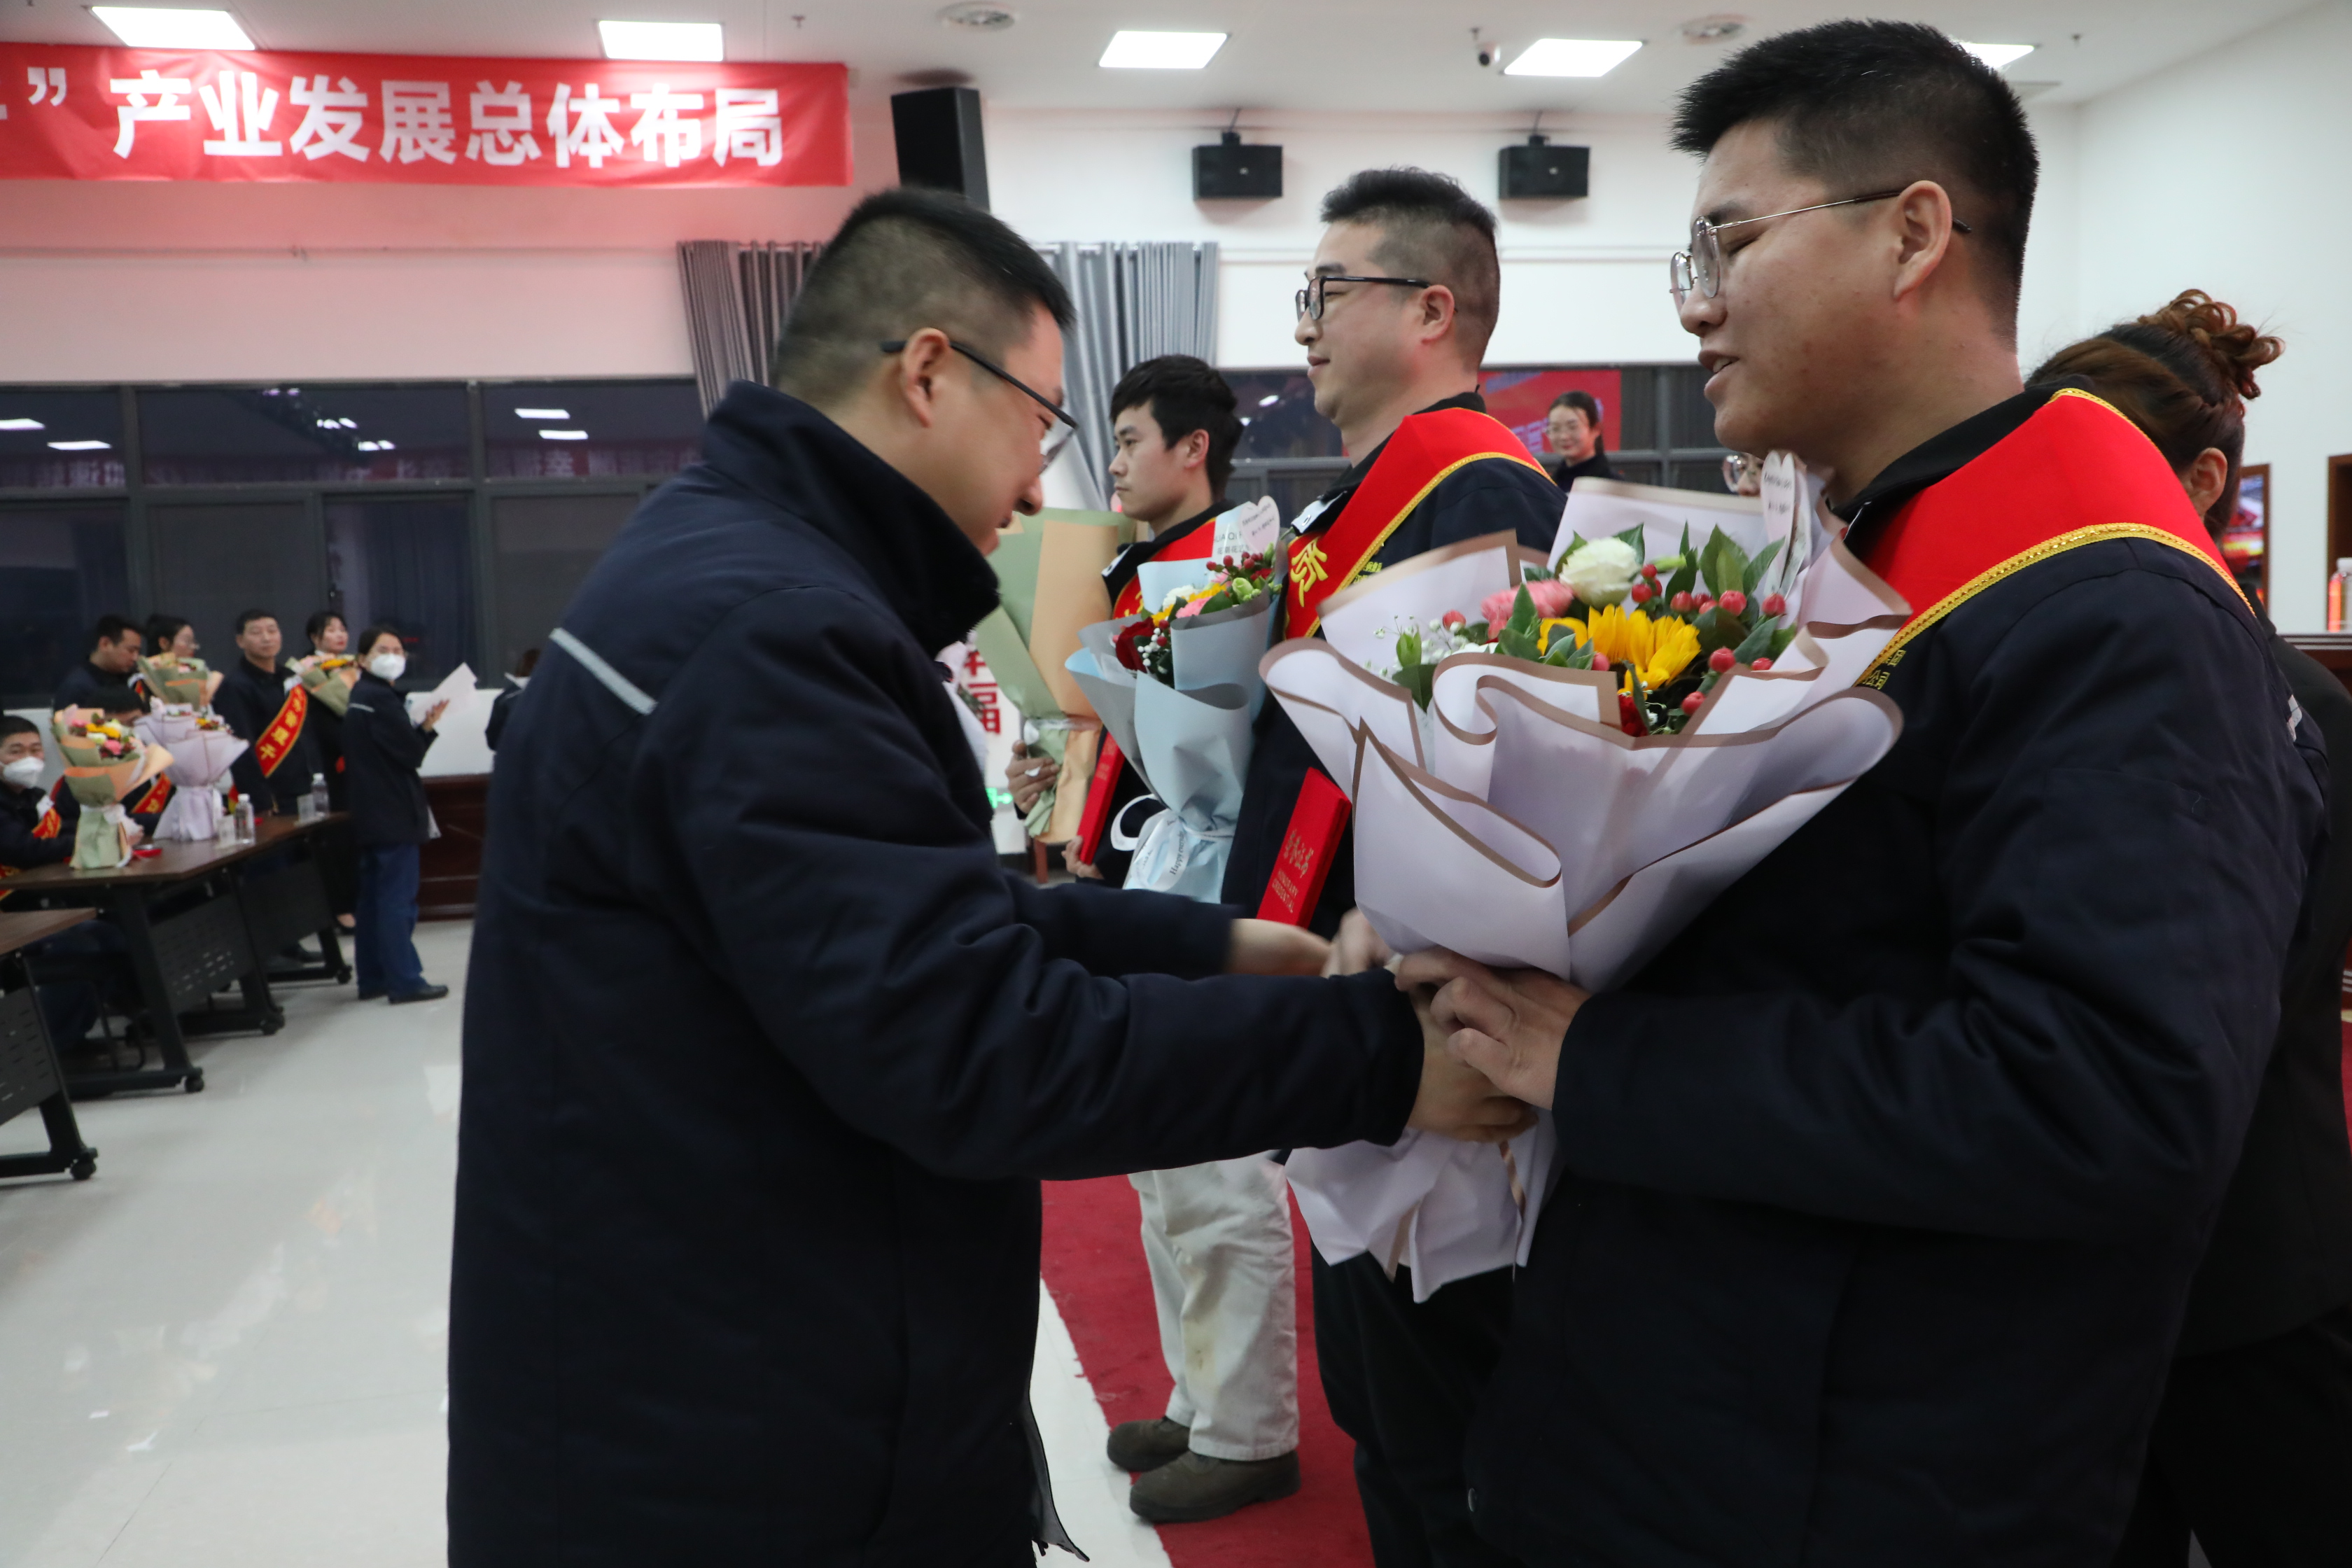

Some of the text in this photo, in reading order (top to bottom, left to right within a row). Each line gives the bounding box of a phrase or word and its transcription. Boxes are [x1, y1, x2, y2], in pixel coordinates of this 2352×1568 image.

[0, 66, 783, 168] ”产业发展总体布局
